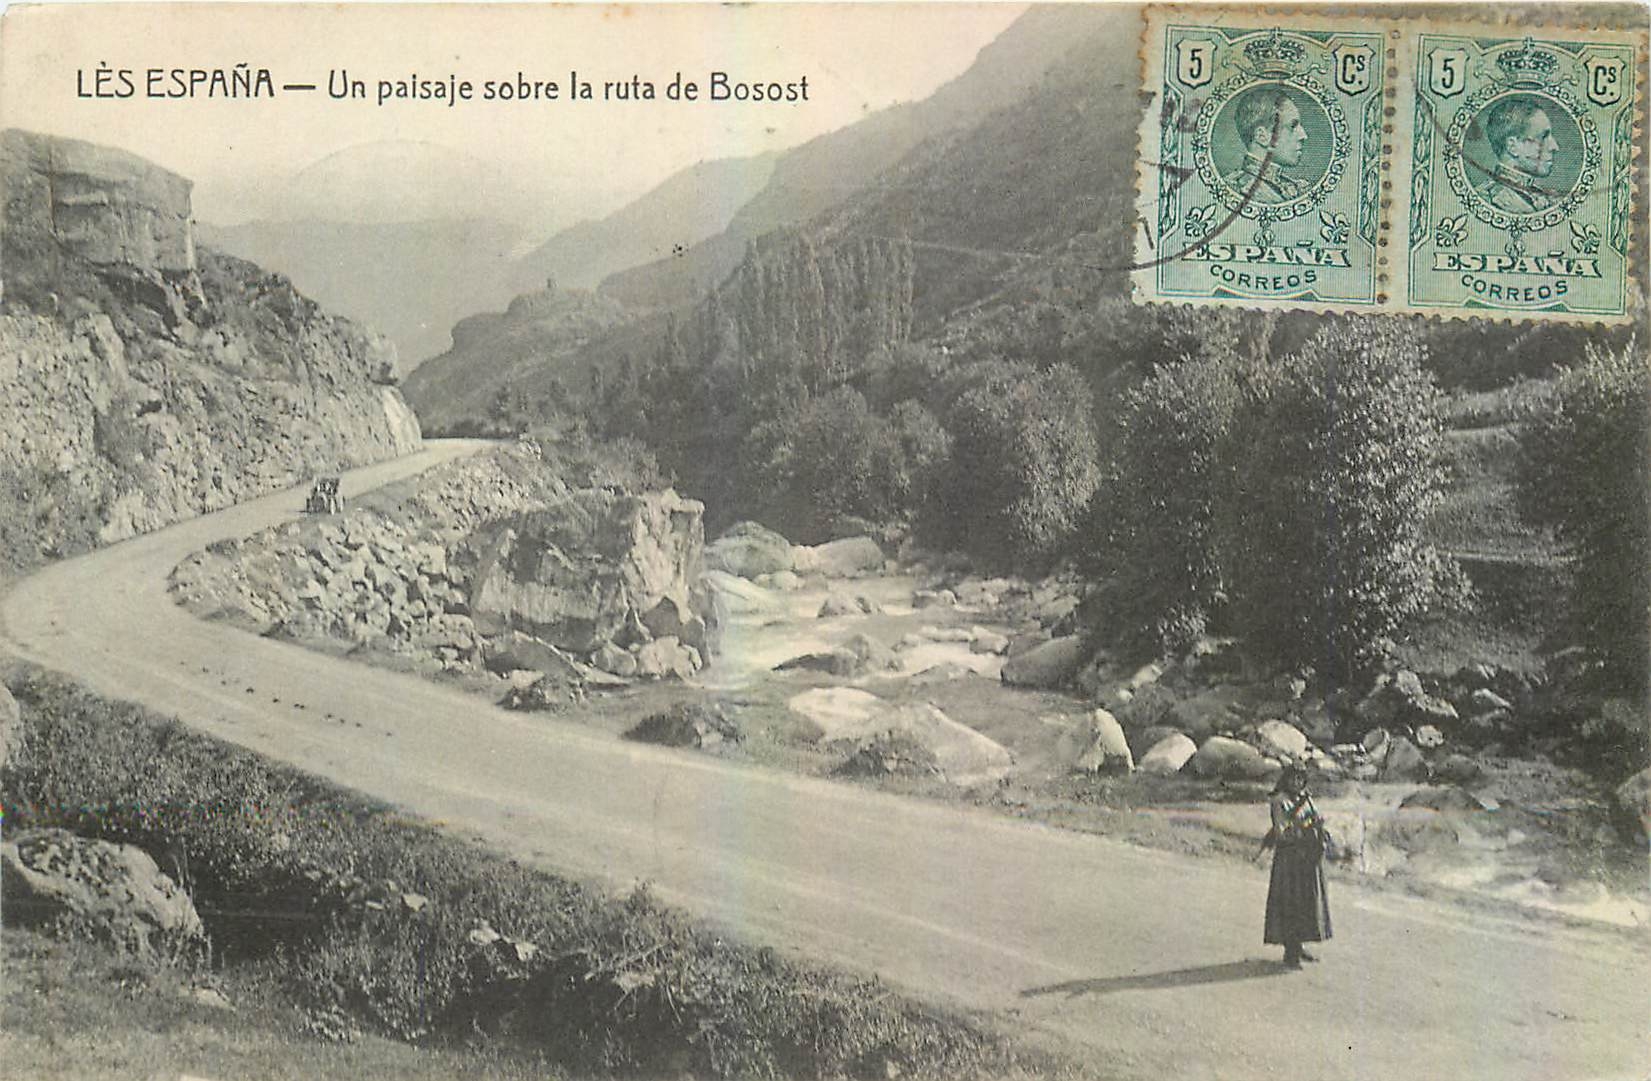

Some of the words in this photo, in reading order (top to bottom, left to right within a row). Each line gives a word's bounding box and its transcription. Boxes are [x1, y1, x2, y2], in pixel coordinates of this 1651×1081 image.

[1189, 48, 1203, 80] 5
[1442, 58, 1455, 88] 5
[1181, 240, 1352, 267] ESPAÑA
[1432, 251, 1602, 278] ESPAÑA
[1210, 265, 1317, 288] CORREOS
[1461, 274, 1569, 301] CORREOS
